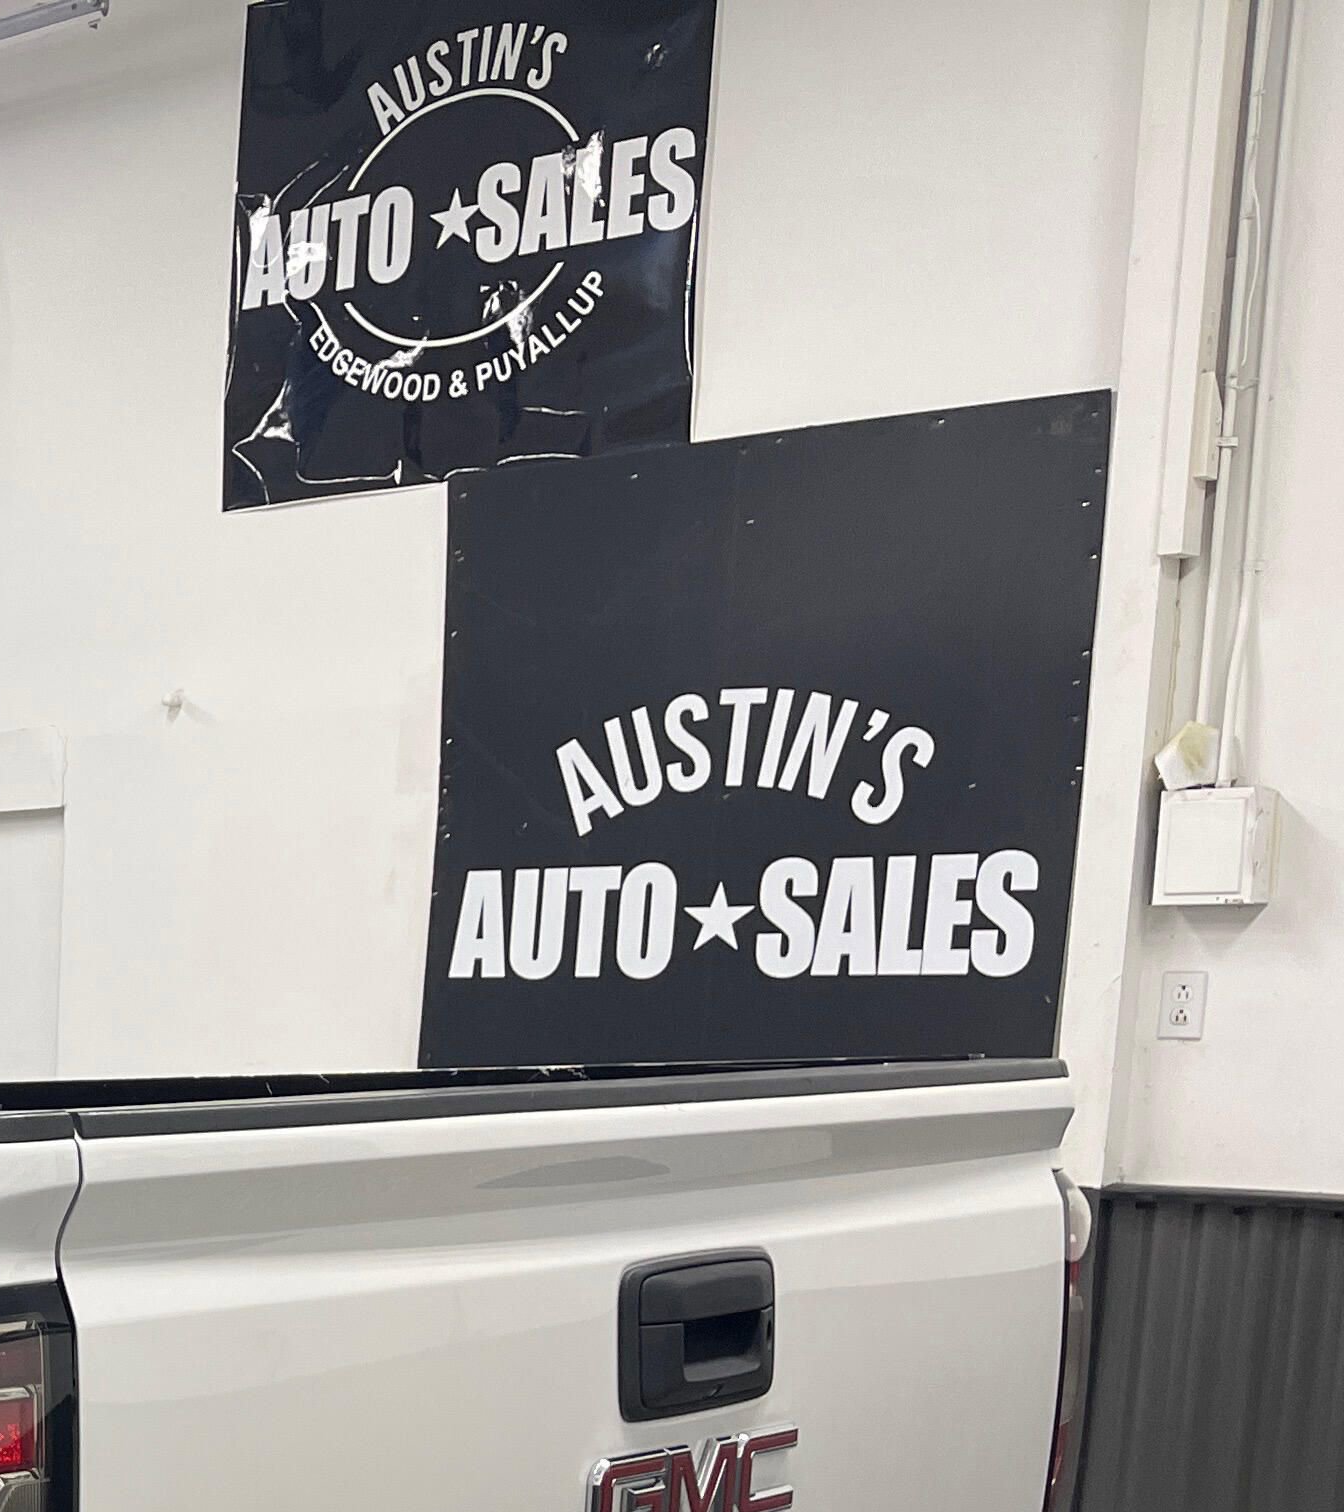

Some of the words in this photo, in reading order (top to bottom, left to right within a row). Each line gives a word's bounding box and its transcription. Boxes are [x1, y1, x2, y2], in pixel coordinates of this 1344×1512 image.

[367, 22, 568, 136] AUSTIN'S
[242, 186, 414, 310] AUTO
[474, 127, 697, 263] SALES
[308, 327, 441, 402] EDGEWOOD
[448, 370, 468, 397] &
[476, 270, 606, 391] PUYALLUP
[555, 686, 936, 837] AUSTIN'S
[448, 861, 678, 980] AUTO
[755, 849, 1039, 979] SALES
